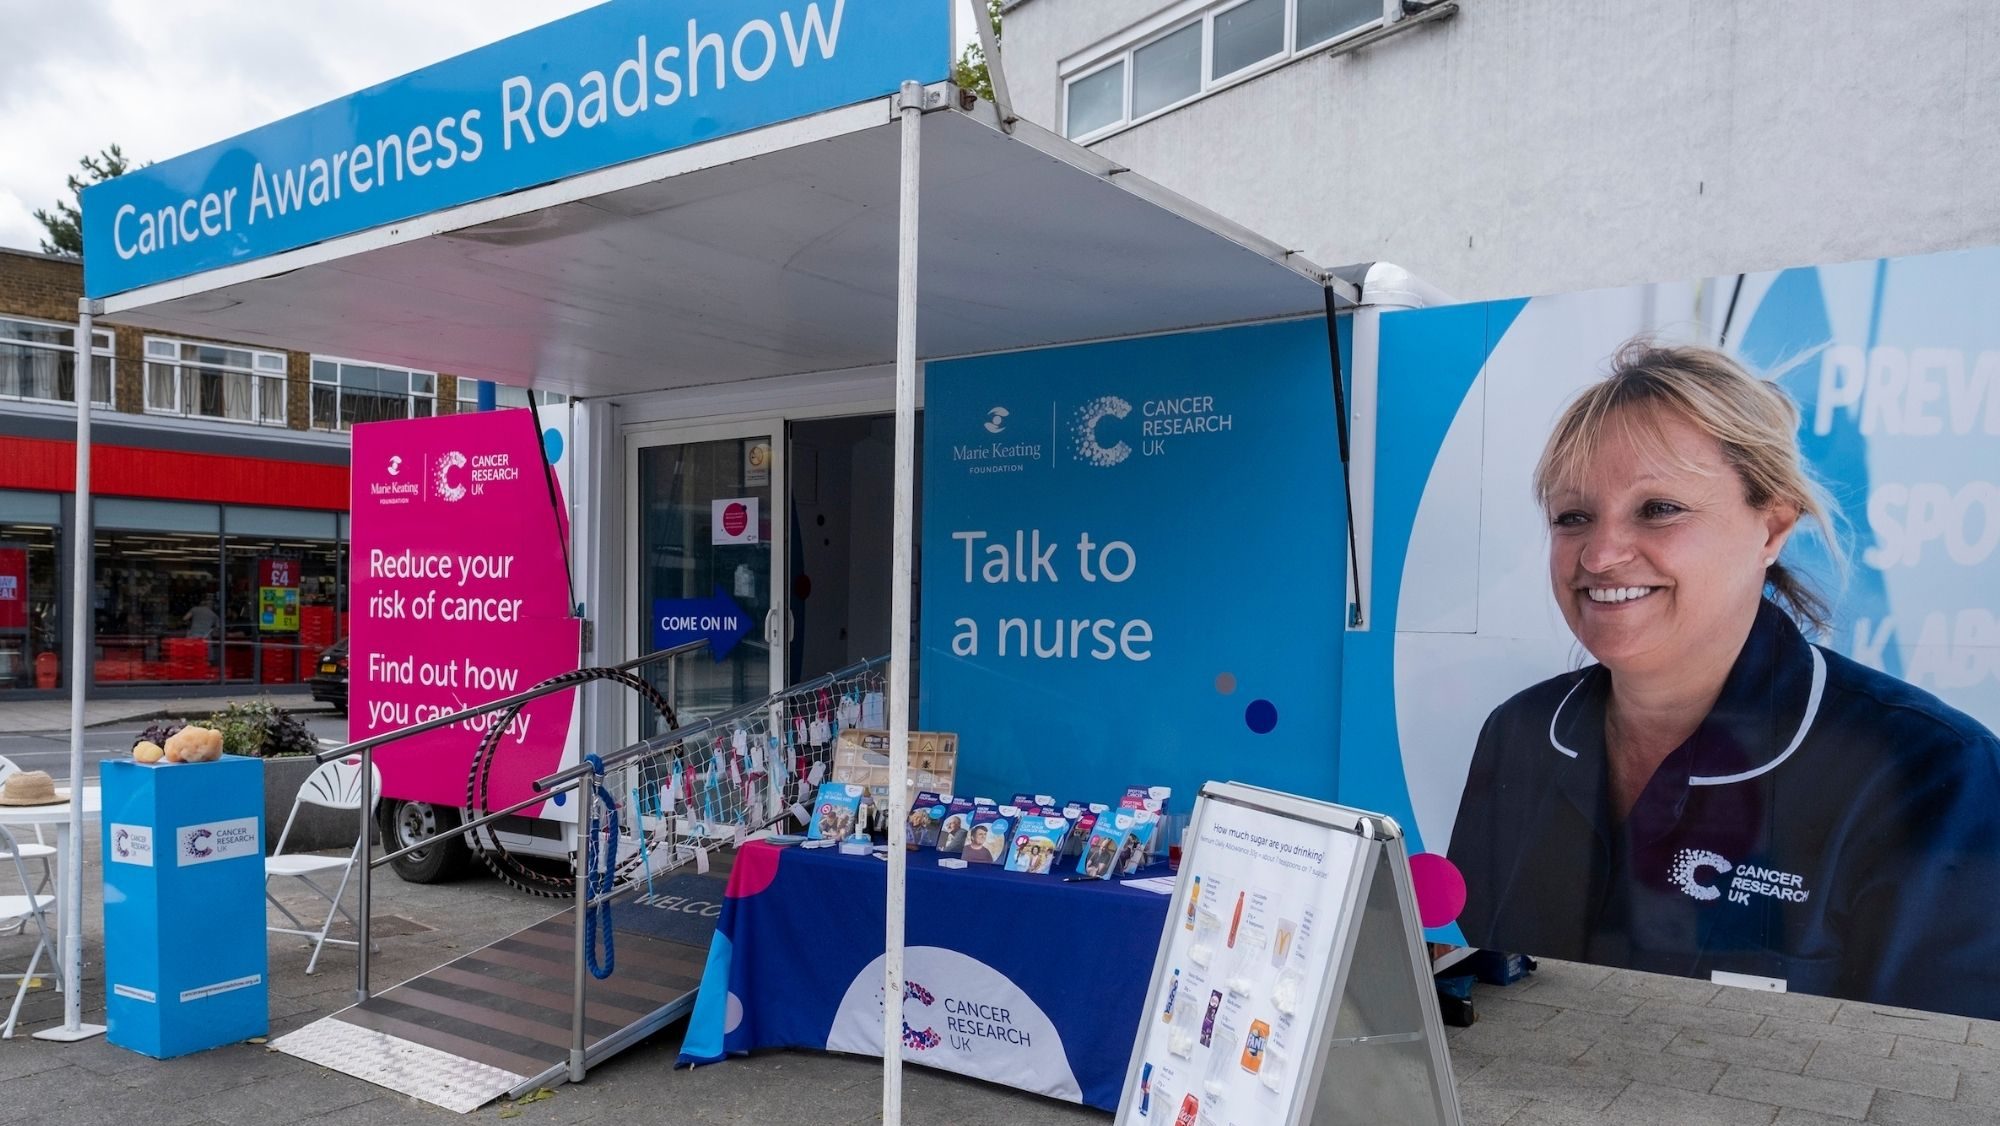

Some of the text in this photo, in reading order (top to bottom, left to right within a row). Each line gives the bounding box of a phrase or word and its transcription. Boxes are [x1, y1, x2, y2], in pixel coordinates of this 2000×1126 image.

[114, 0, 845, 260] Cancer Awareness Roadshow
[1143, 396, 1213, 417] CANCER
[1143, 415, 1232, 437] RESEARCH
[954, 442, 1041, 461] Marie Keating
[1143, 440, 1165, 457] UK
[472, 454, 509, 467] CANCER
[970, 464, 1023, 474] FOUNDATION
[472, 468, 518, 482] RESEARCH
[371, 482, 419, 495] Marie Keating
[472, 484, 484, 495] UK
[952, 529, 1136, 584] Talk to
[272, 571, 289, 586] £4
[370, 549, 514, 587] Reduce your
[370, 590, 522, 622] risk of cancer
[662, 617, 737, 631] COME ON IN
[952, 617, 1153, 662] a nurse
[1905, 608, 2000, 688] AB
[369, 653, 518, 691] Find out how
[368, 701, 408, 730] you
[415, 704, 454, 728] can
[217, 828, 247, 837] CANCER
[217, 835, 254, 845] RESEARCH
[1214, 823, 1227, 835] How
[1229, 828, 1249, 841] much
[1251, 834, 1268, 847] sugar
[1269, 840, 1279, 849] are
[1280, 843, 1293, 853] you
[1736, 865, 1803, 888] CANCER
[1728, 890, 1751, 906] UK
[1731, 877, 1810, 903] RESEARCH
[634, 893, 723, 917] WELCO
[945, 998, 1012, 1024] CANCER
[948, 1017, 1031, 1047] RESEARCH
[950, 1035, 972, 1052] UK
